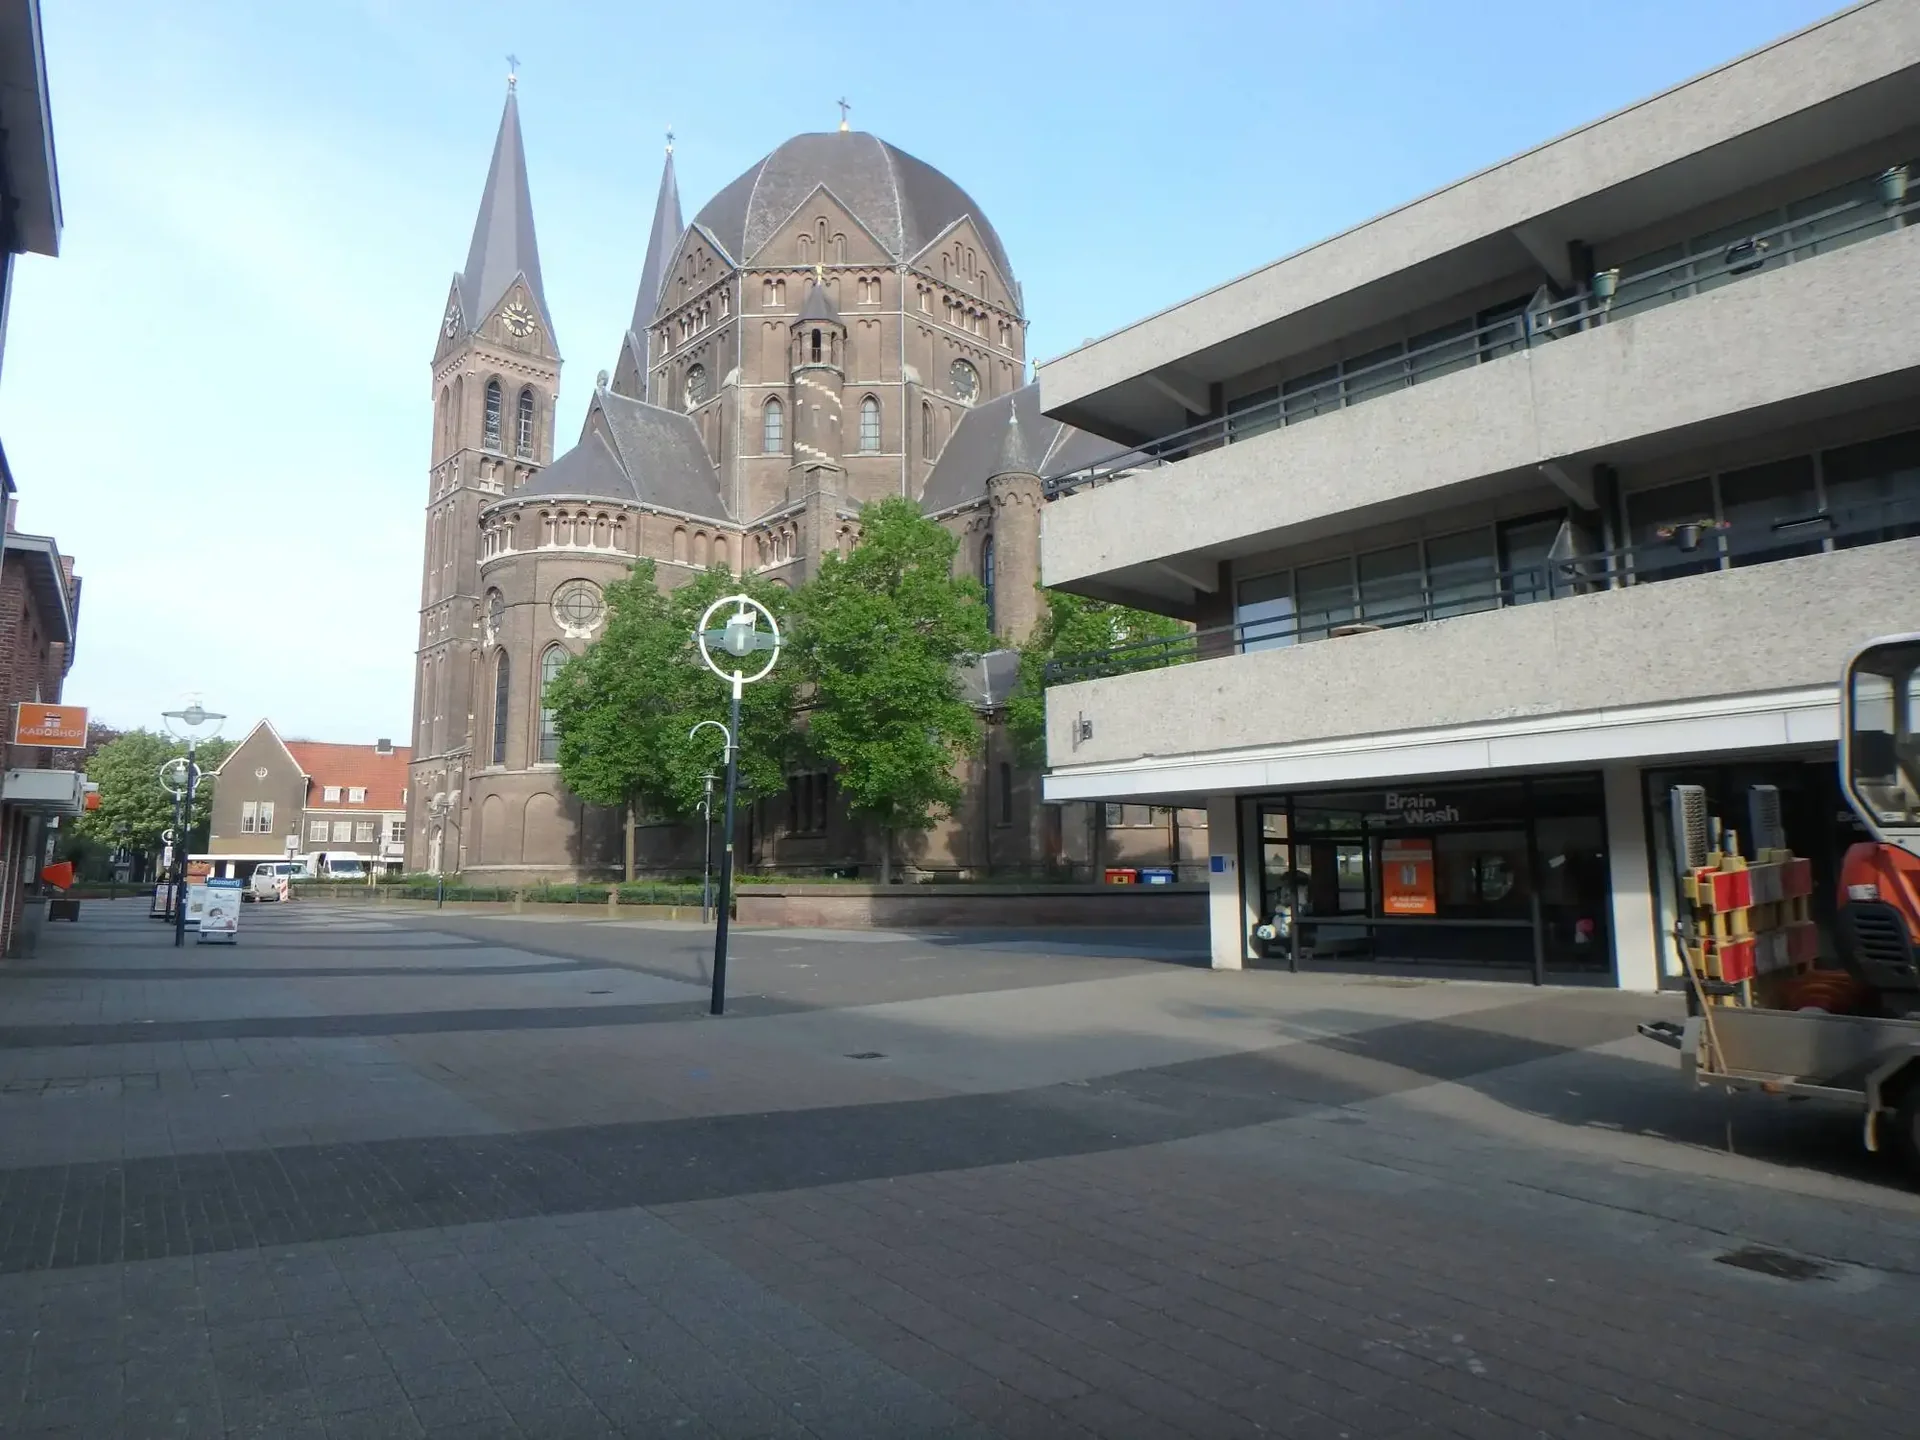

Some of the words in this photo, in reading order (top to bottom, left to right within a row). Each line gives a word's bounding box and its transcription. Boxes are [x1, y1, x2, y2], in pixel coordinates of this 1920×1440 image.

[20, 727, 84, 738] KADOSHOP
[1386, 792, 1437, 809] Brain
[1404, 805, 1460, 824] Wash
